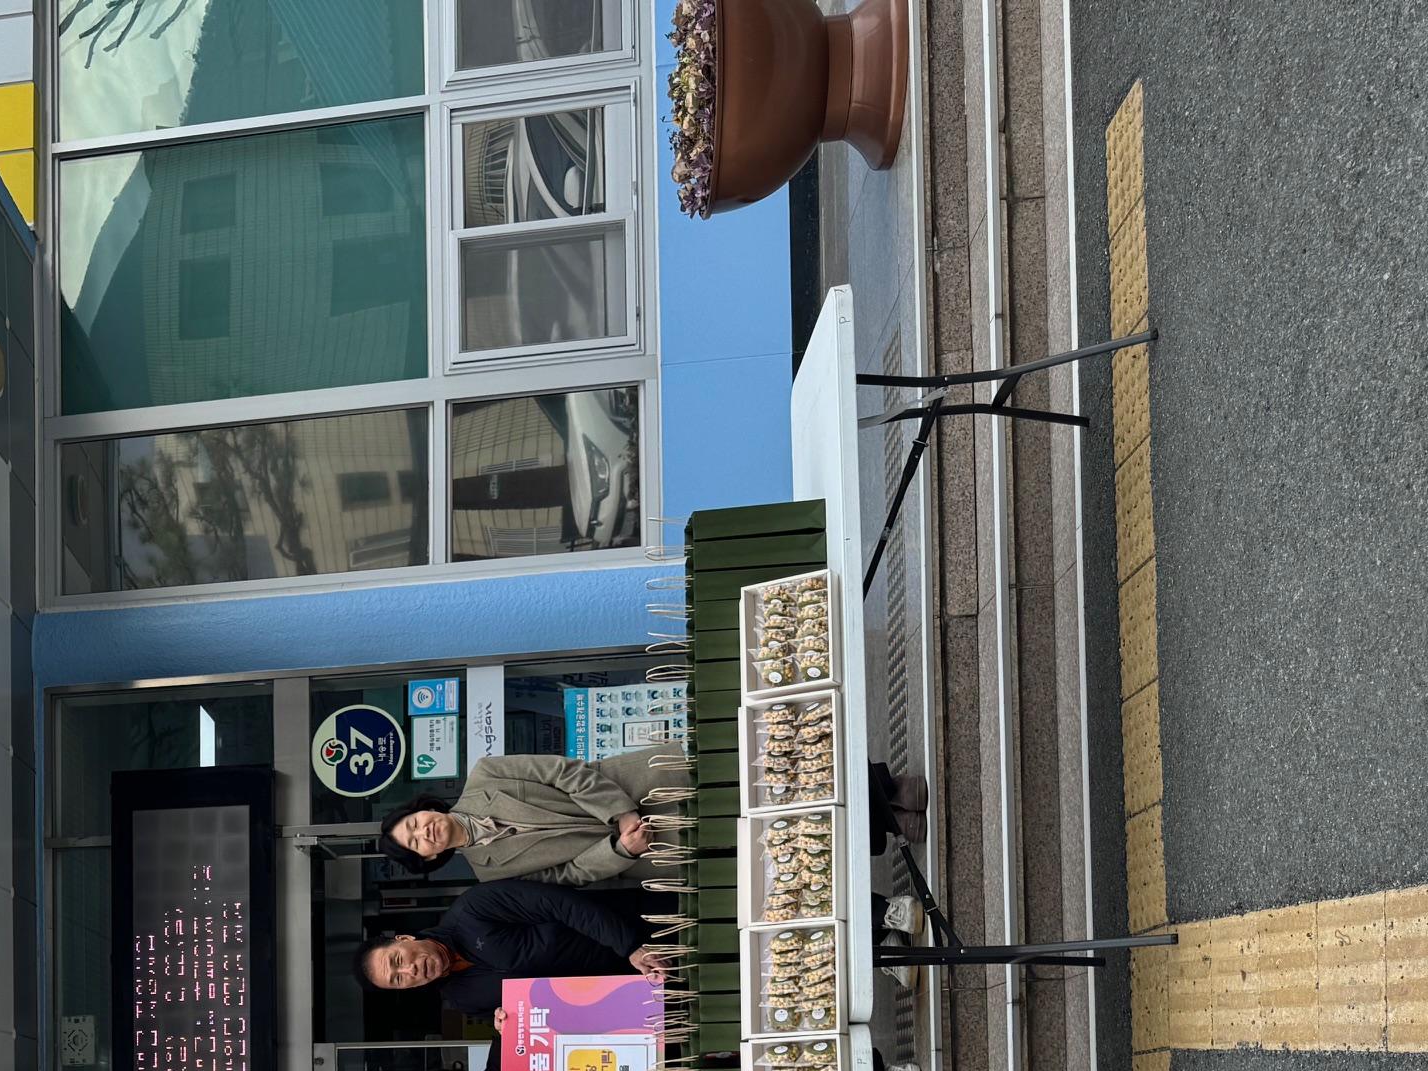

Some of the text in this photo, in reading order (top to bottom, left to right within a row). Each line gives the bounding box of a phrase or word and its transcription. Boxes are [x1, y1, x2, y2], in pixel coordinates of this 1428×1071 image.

[484, 701, 496, 757] ngsan
[349, 726, 375, 776] 37
[377, 736, 387, 762] 내송로
[529, 1007, 550, 1046] 기탁
[601, 1050, 613, 1071] 기탁
